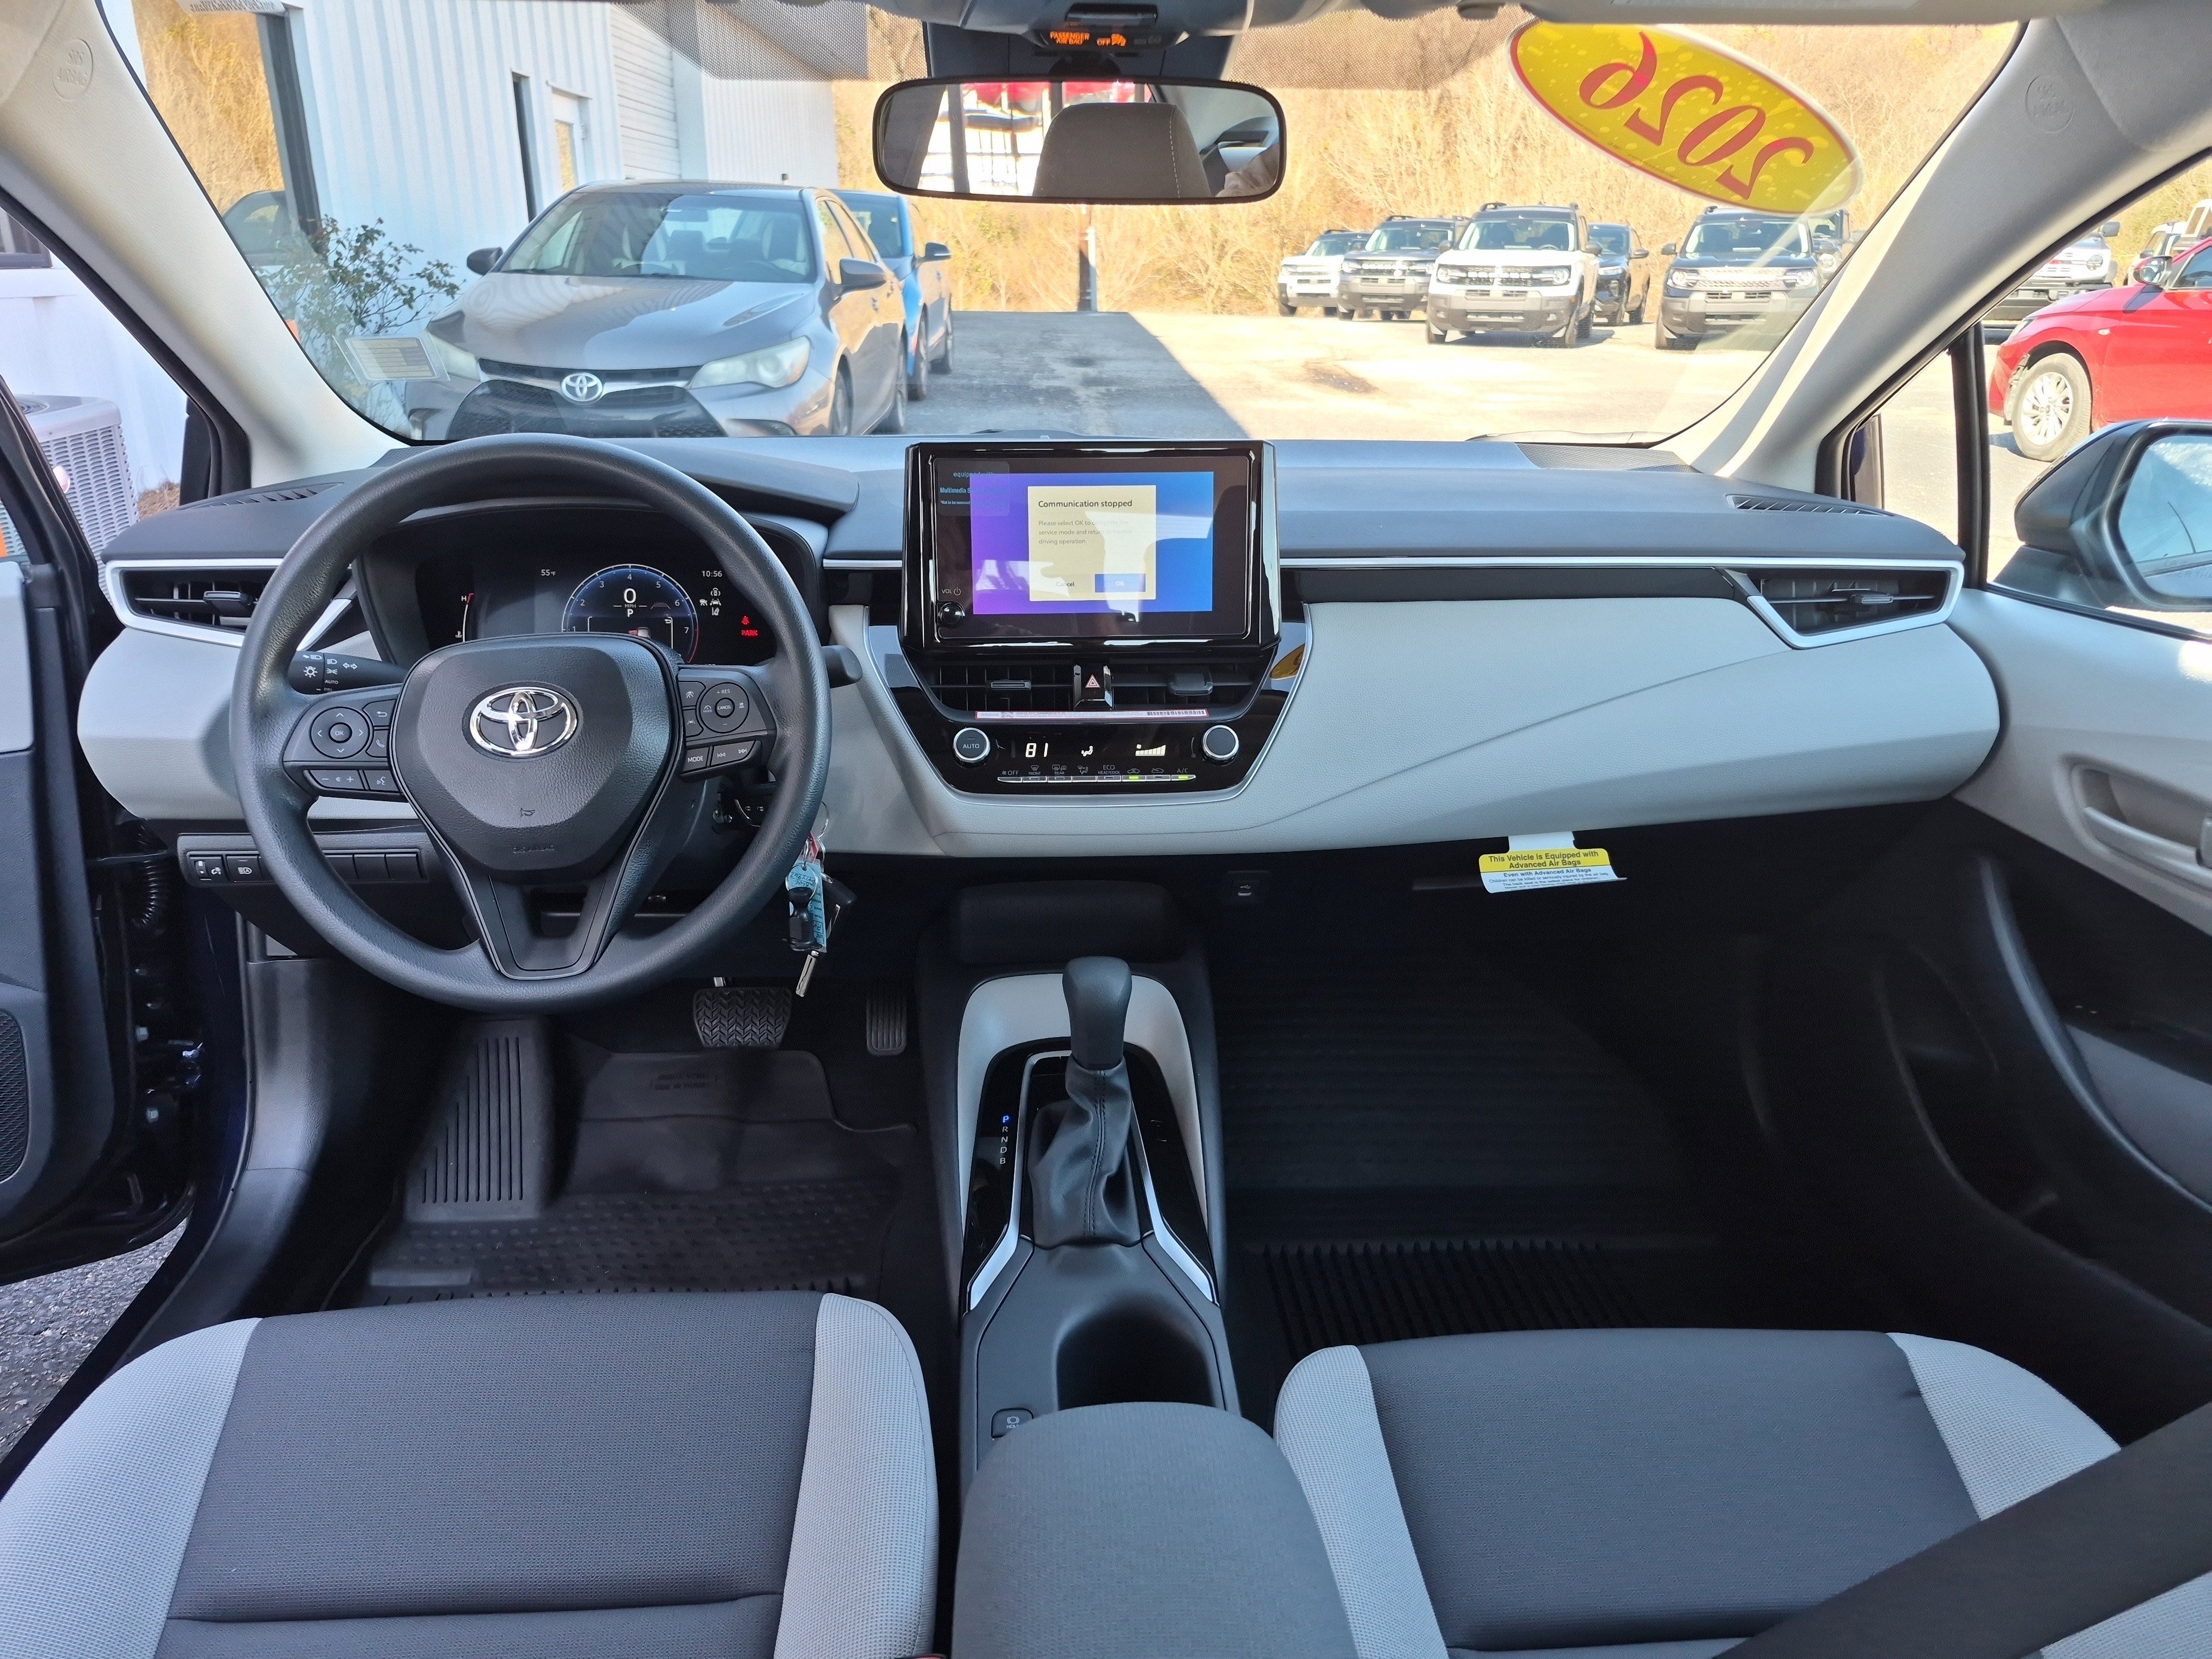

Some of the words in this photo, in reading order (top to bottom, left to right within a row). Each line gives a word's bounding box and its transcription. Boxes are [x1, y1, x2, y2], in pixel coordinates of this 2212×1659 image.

[1097, 37, 1111, 46] OFF
[1038, 500, 1099, 508] Communication
[1101, 500, 1133, 509] stopped
[623, 588, 636, 603] 0
[627, 609, 634, 618] P
[1025, 743, 1049, 757] 81
[1545, 851, 1580, 860] Equipped
[1509, 860, 1546, 869] Advanced
